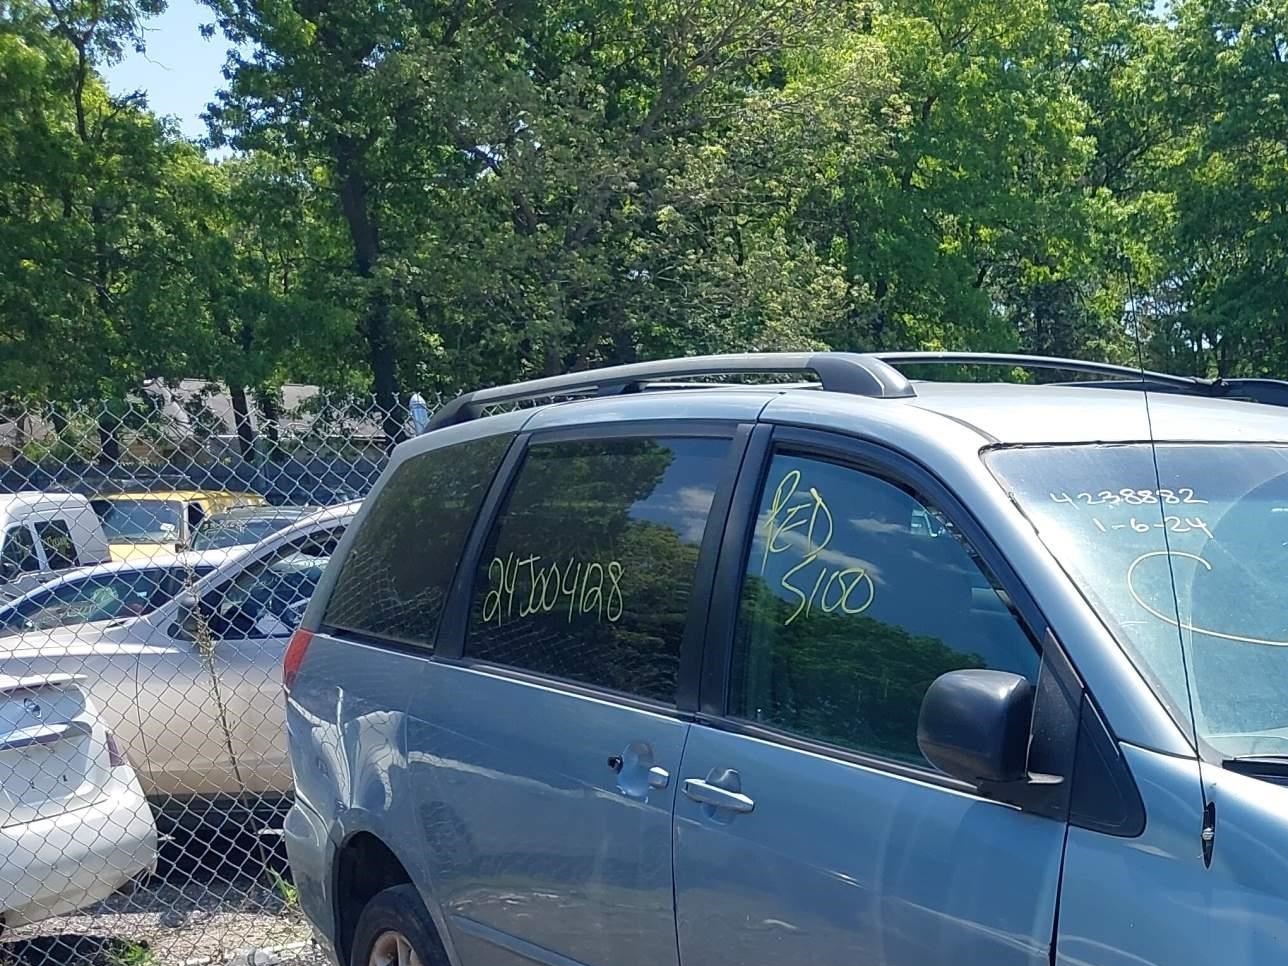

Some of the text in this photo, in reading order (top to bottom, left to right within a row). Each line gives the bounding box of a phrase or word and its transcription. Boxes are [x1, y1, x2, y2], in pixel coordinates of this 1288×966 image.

[1049, 488, 1209, 511] 4238882
[1091, 515, 1214, 539] 1-6-24
[483, 551, 626, 628] 24J004128
